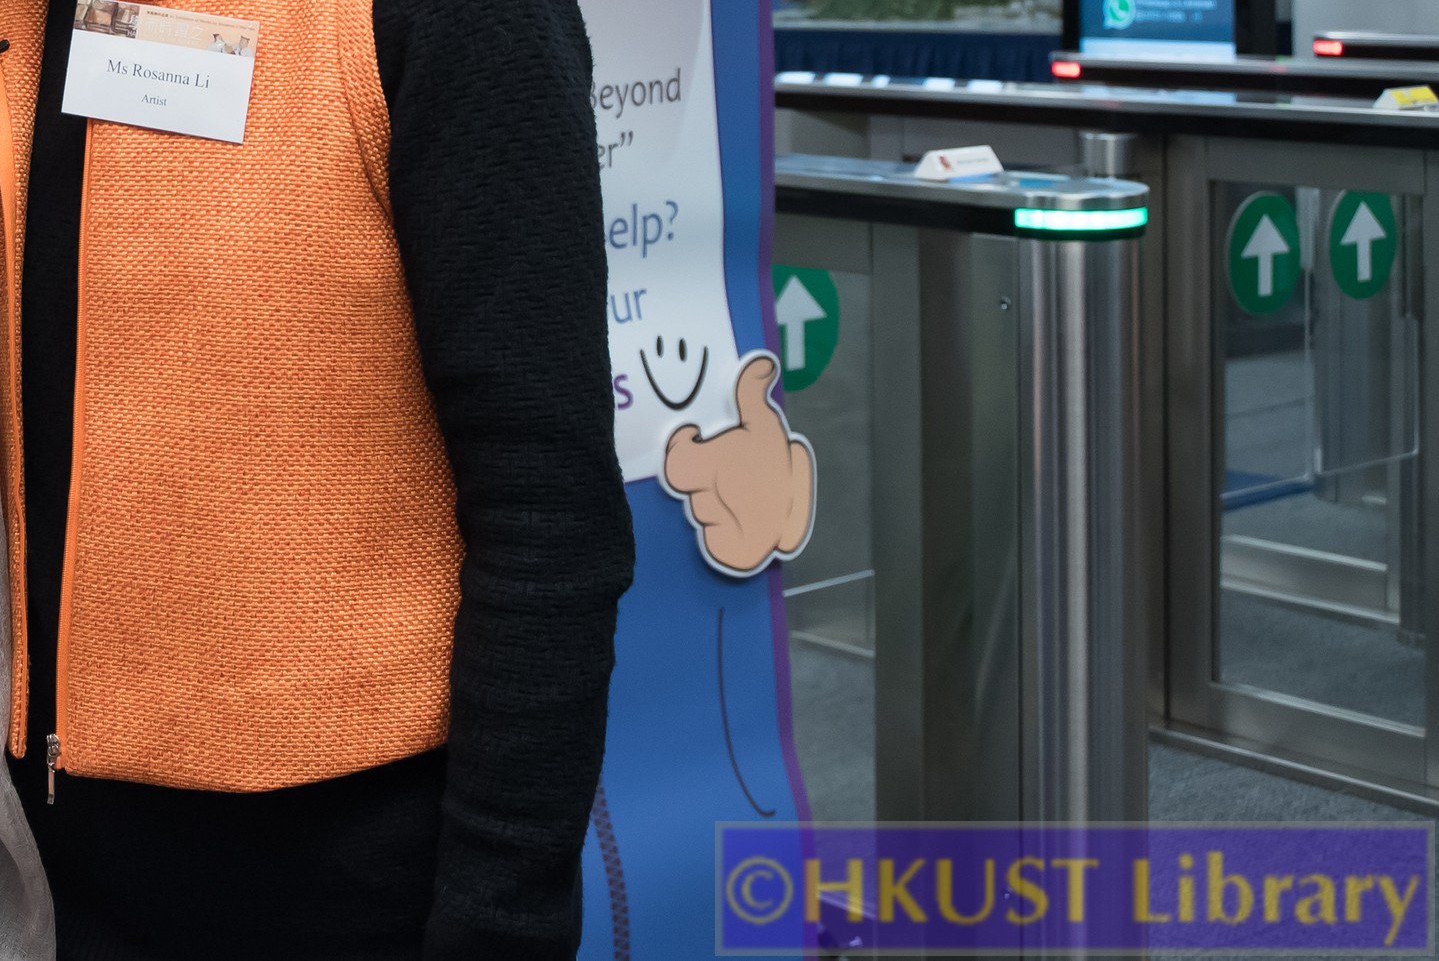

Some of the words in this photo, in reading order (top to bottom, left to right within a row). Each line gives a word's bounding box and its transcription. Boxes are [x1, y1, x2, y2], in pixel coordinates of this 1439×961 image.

[107, 59, 128, 75] Ms
[132, 63, 190, 85] Rosanna
[195, 73, 210, 89] Li
[141, 94, 167, 107] Artist
[607, 200, 679, 259] elp?
[610, 289, 647, 324] ur
